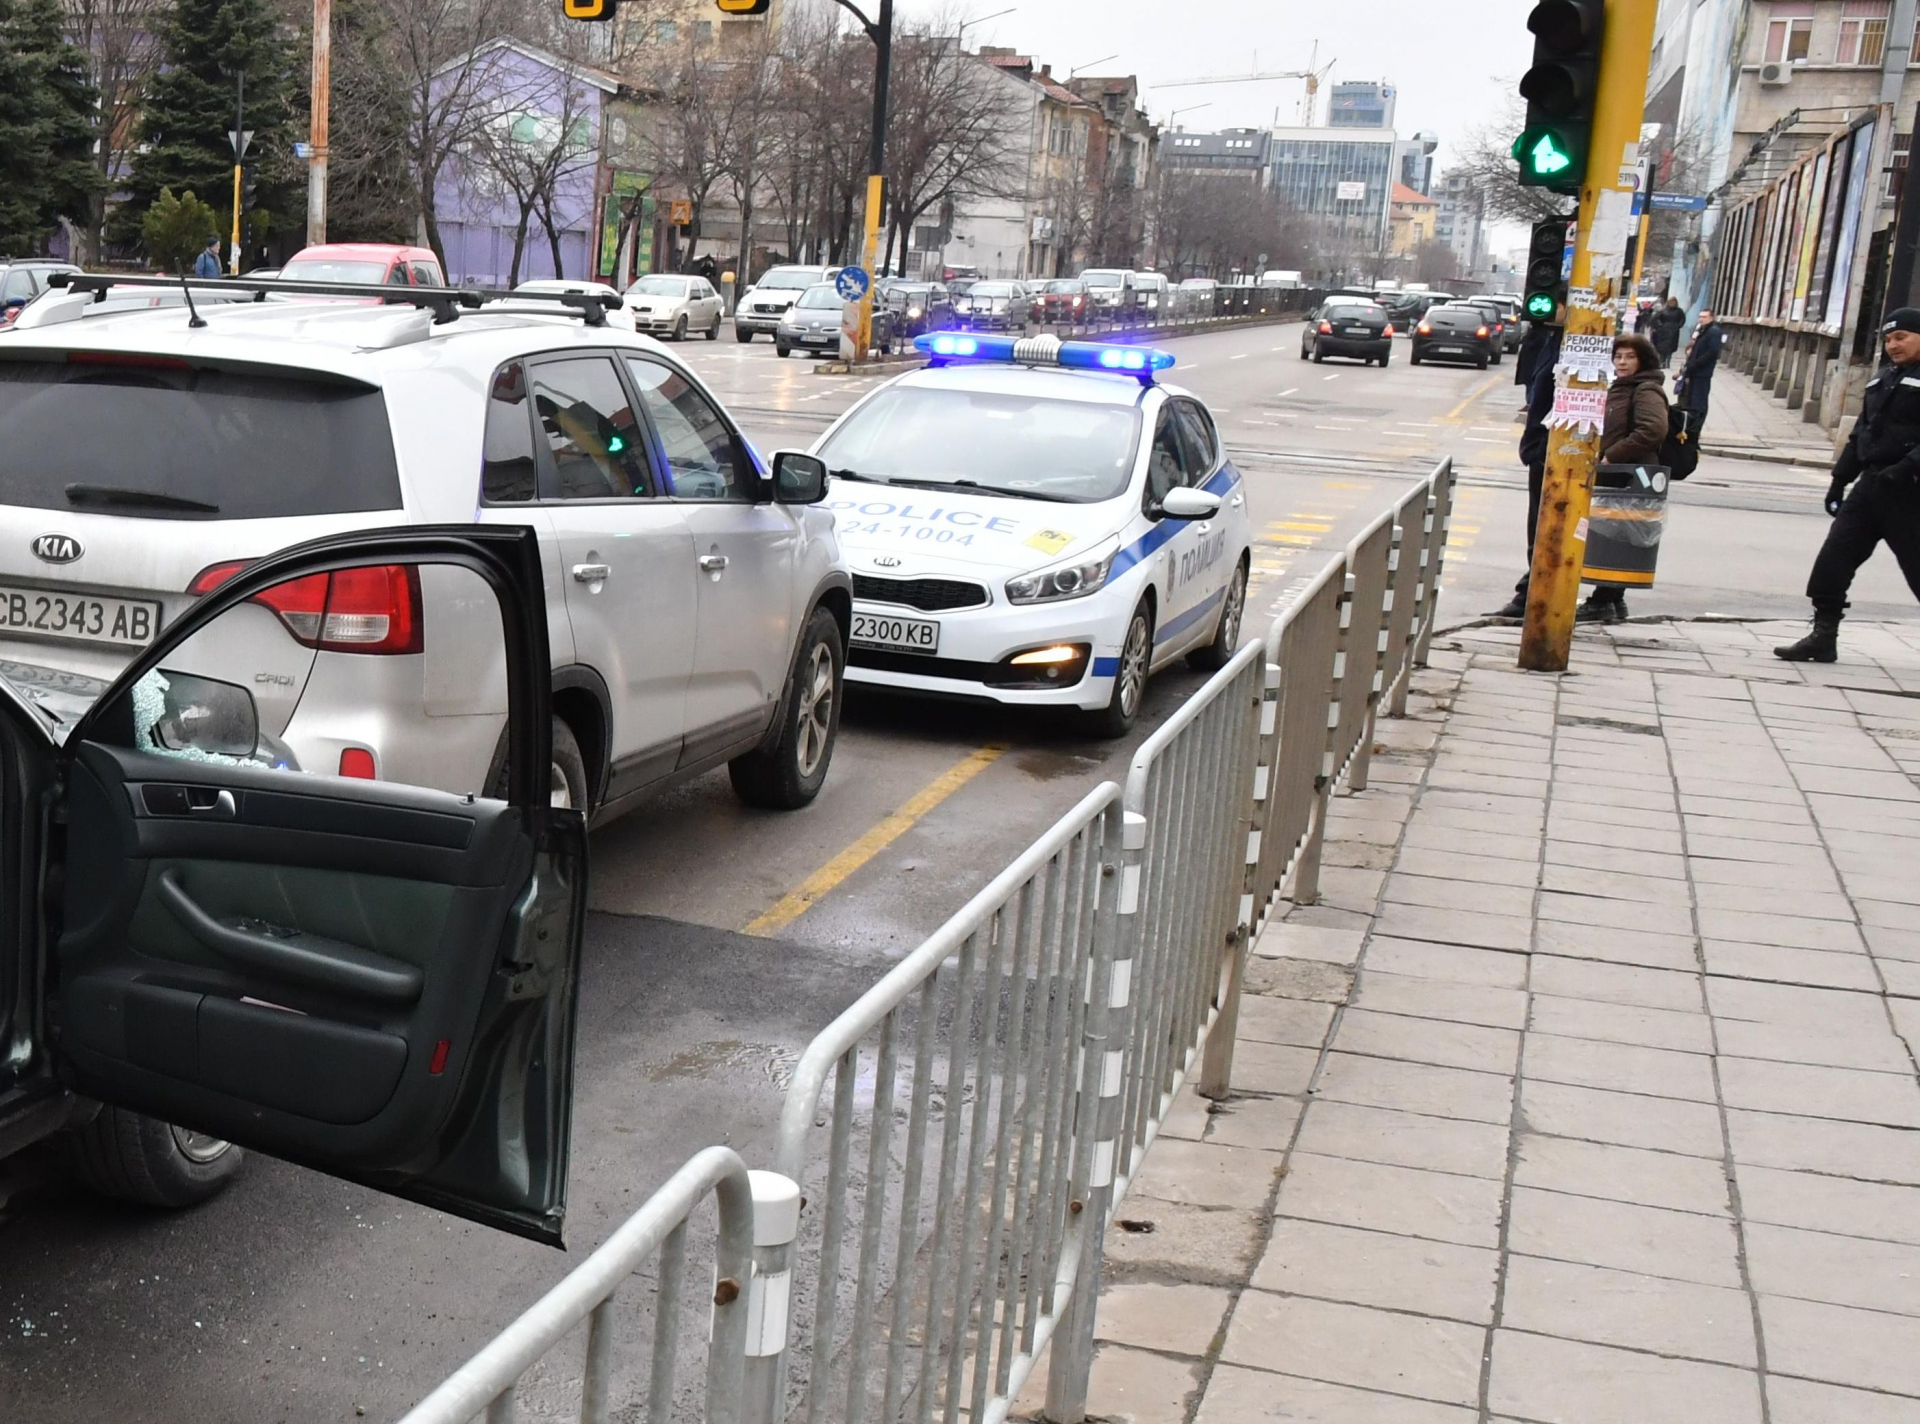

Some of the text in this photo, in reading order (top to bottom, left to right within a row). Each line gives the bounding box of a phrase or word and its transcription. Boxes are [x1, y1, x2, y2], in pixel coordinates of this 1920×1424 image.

[1566, 335, 1610, 347] РЕМОНТ
[829, 501, 1021, 534] POLICE
[37, 536, 75, 559] KIA
[839, 520, 975, 547] 24-1004
[874, 556, 901, 567] KIA
[1180, 528, 1225, 587] ПОЛИЦИЯ
[110, 604, 150, 641] AB
[852, 616, 933, 646] 2300 KB
